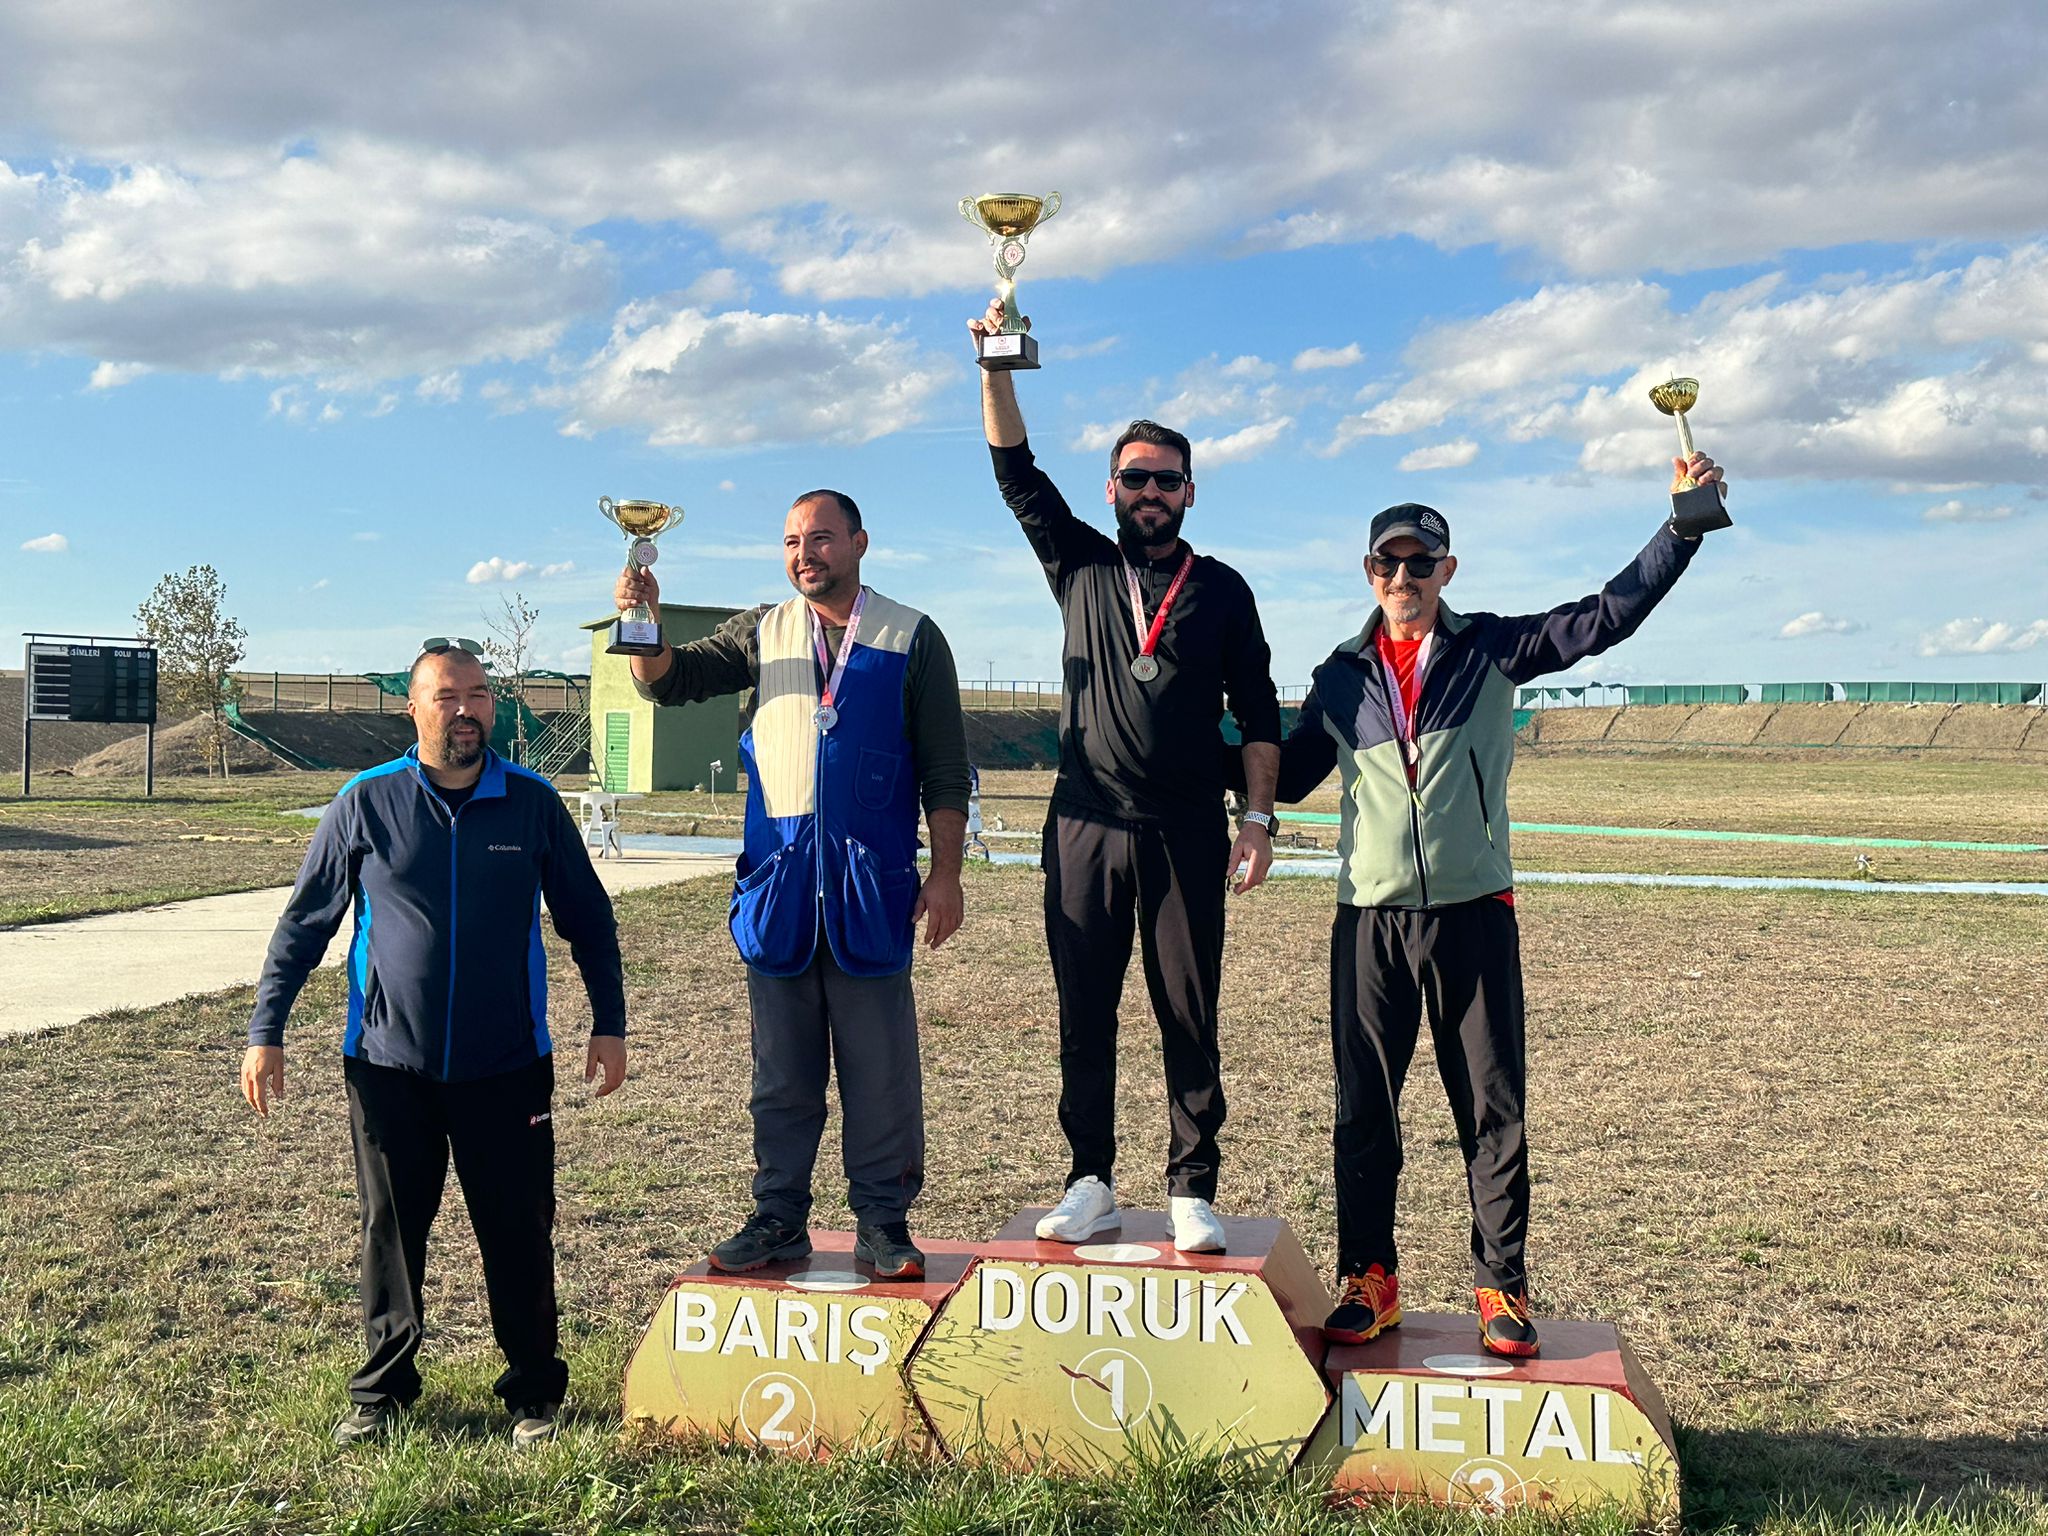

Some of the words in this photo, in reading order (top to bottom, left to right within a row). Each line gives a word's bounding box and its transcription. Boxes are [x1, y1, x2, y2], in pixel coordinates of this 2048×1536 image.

[494, 844, 522, 852] Columbia
[673, 1291, 891, 1376] BARIŞ
[978, 1267, 1253, 1346] DORUK
[759, 1382, 796, 1442] 2
[1100, 1359, 1125, 1421] 1
[1338, 1379, 1643, 1465] METAL
